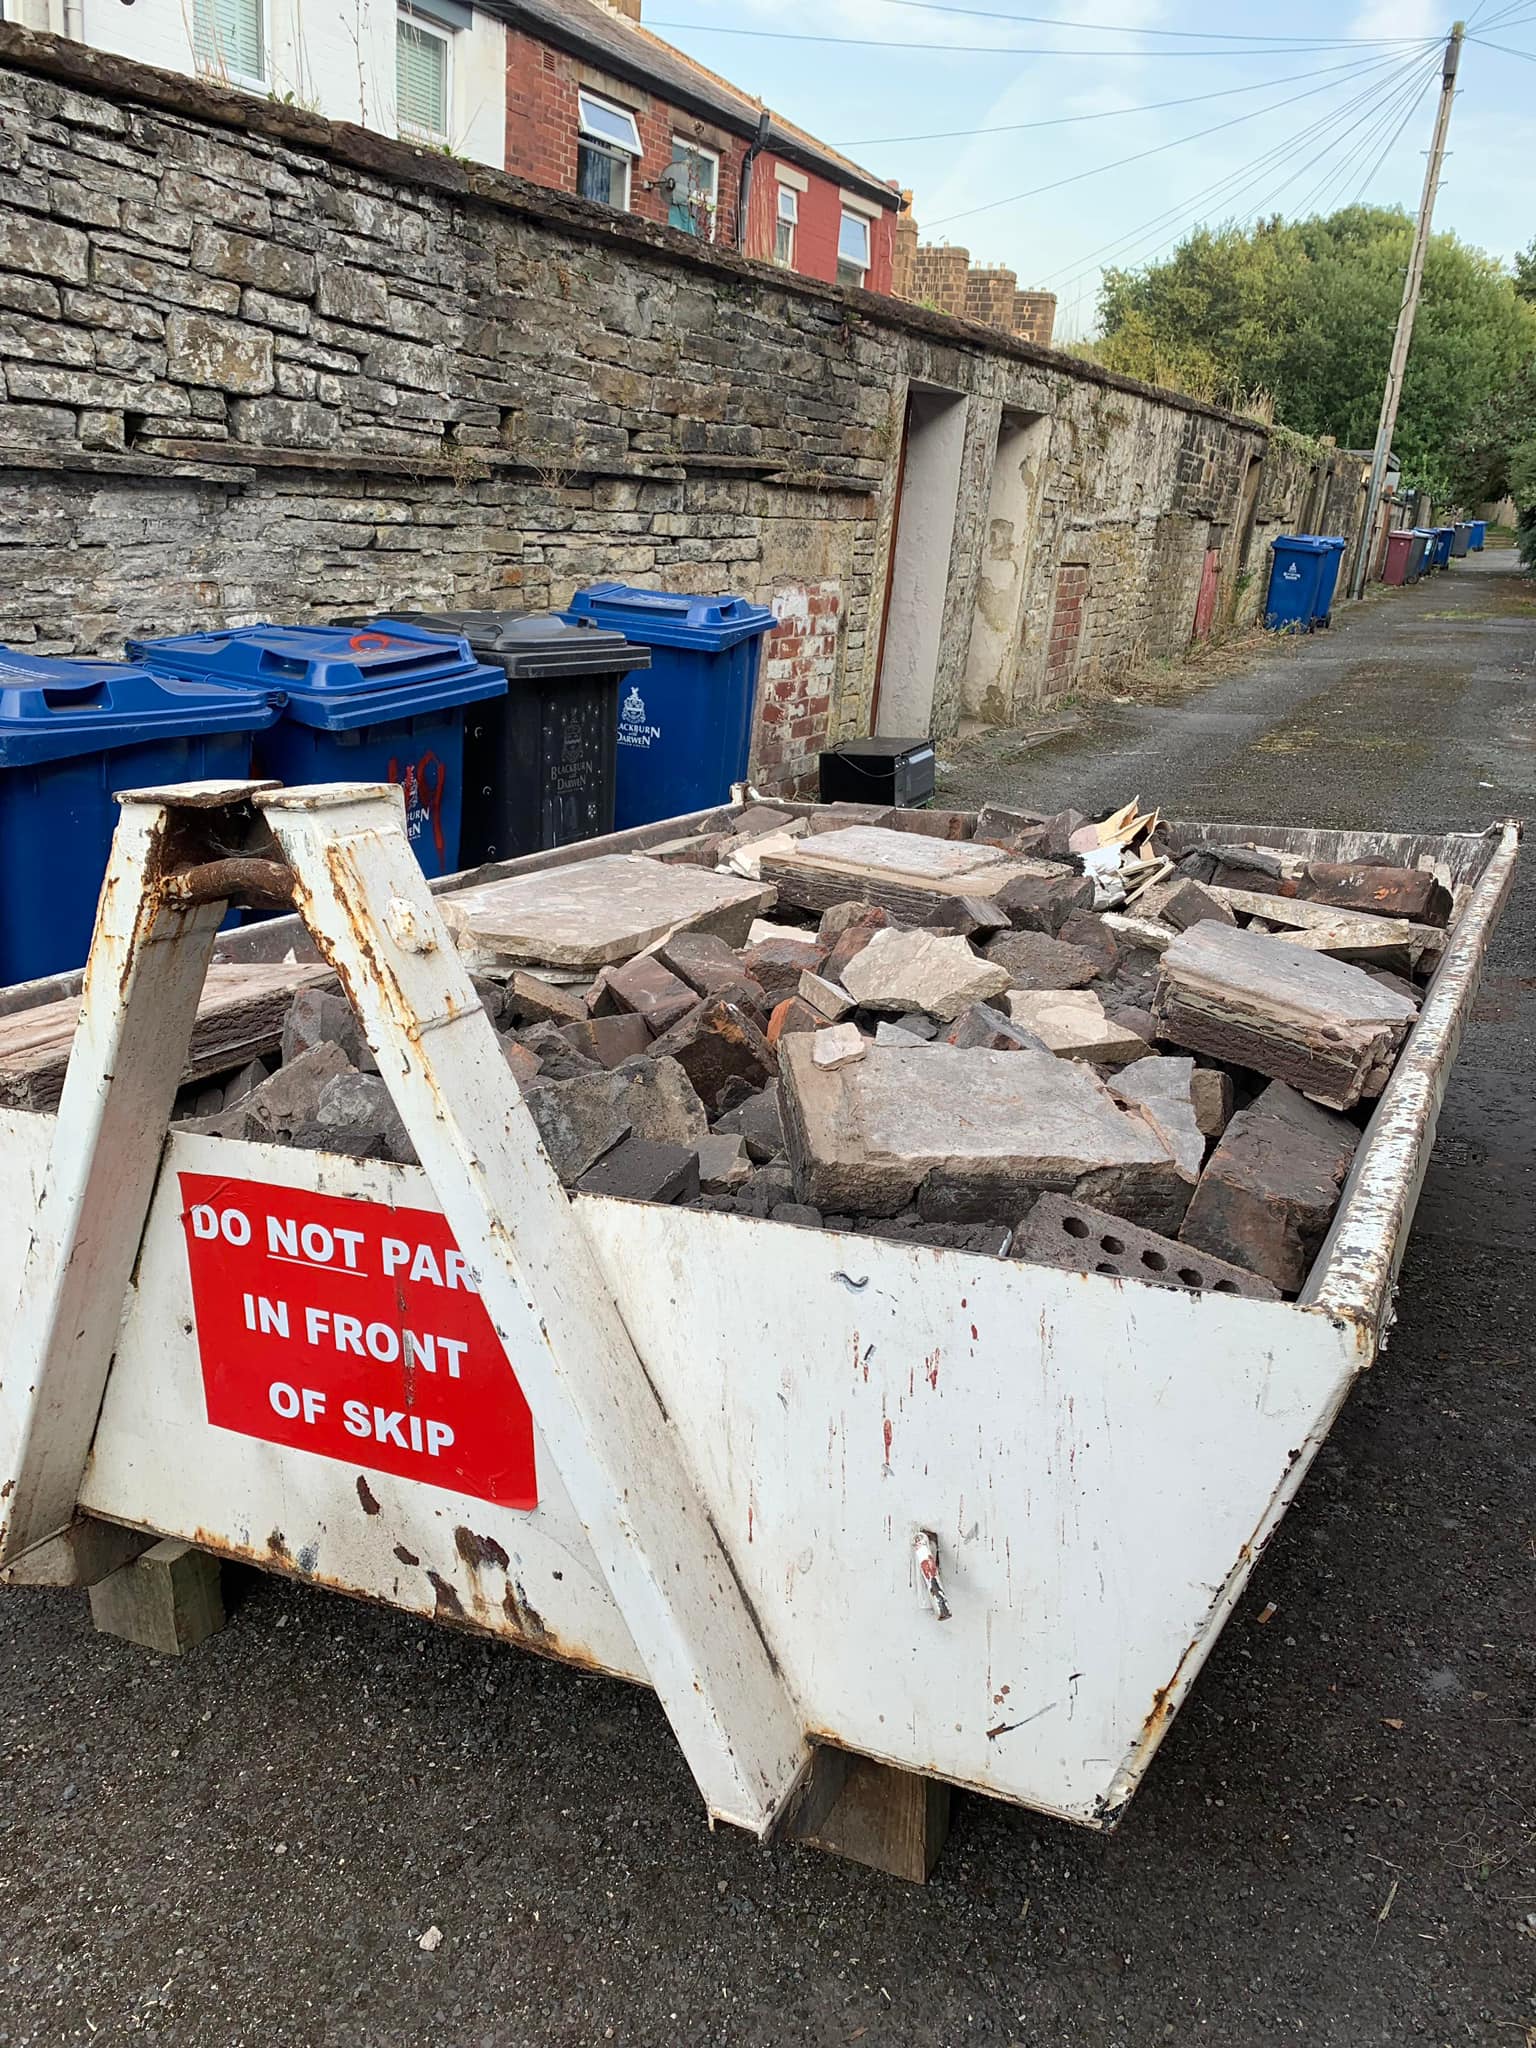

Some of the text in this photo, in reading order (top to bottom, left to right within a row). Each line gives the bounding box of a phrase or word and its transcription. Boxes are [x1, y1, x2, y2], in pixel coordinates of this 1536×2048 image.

[616, 722, 661, 739] ACKBURN
[190, 1204, 480, 1294] DO NOT PAR
[243, 1293, 469, 1379] IN FRONT
[268, 1381, 456, 1457] OF SKIP
